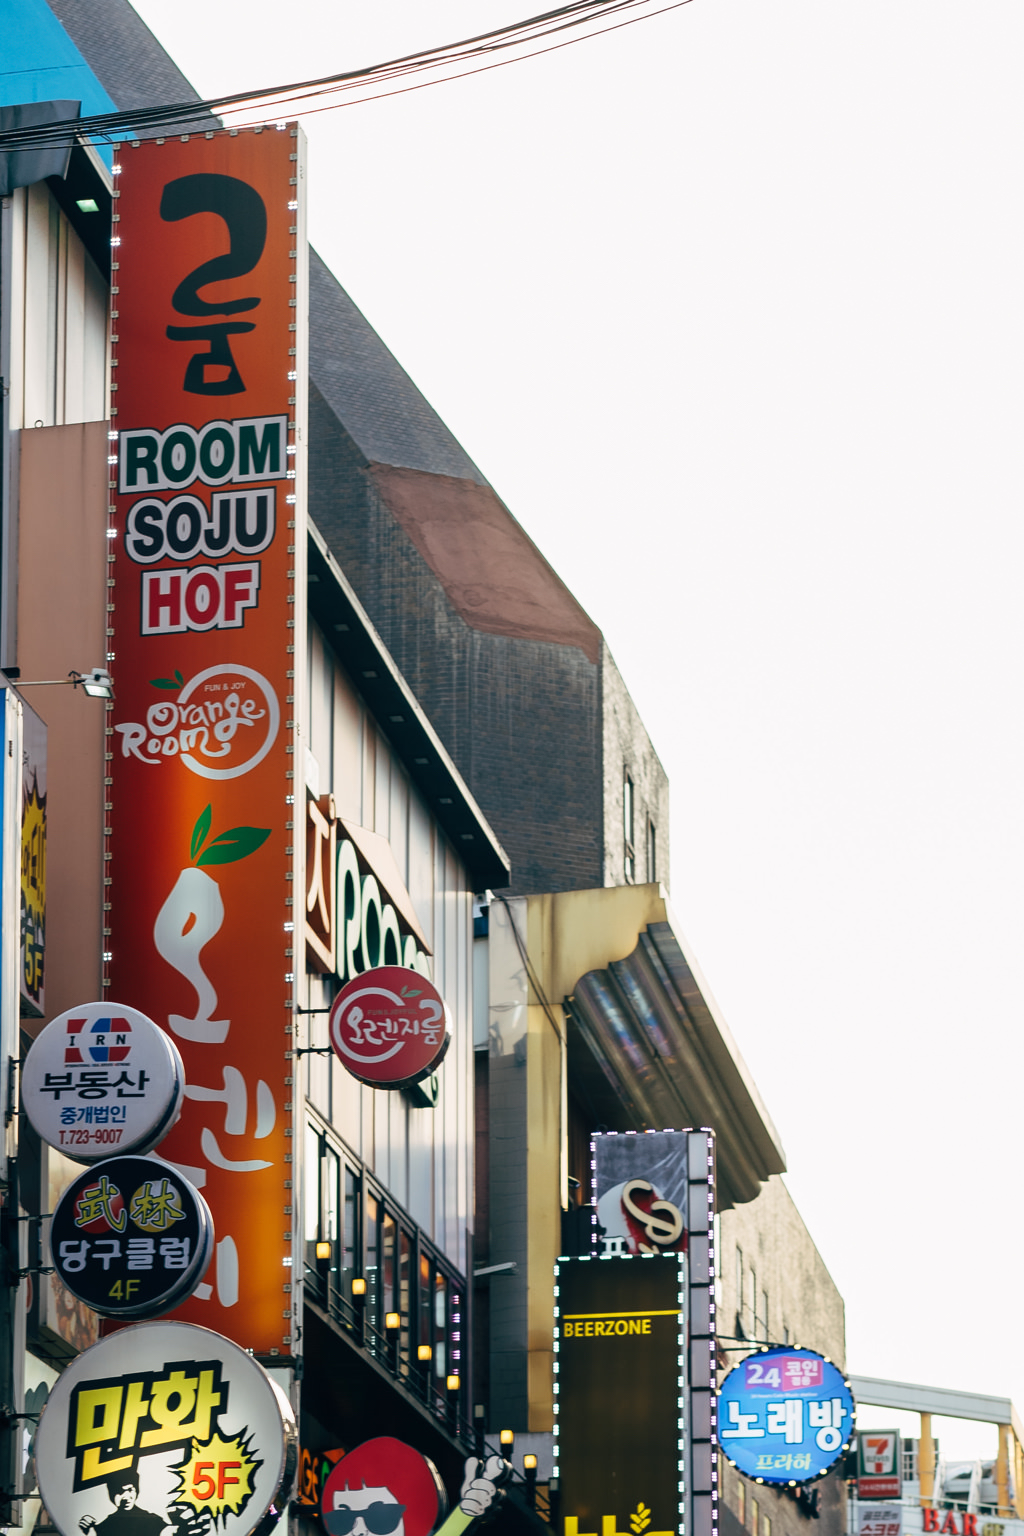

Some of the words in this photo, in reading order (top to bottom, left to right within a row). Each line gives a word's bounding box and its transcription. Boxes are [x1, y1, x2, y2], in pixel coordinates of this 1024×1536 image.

[160, 172, 268, 397] 룸
[121, 418, 285, 491] ROOM
[128, 490, 274, 561] SOJU
[144, 564, 258, 632] HOF
[24, 930, 44, 991] 5F
[347, 1000, 442, 1046] 오렌지룸
[39, 1070, 151, 1100] 부동산
[59, 1105, 127, 1126] 중개법인
[58, 1128, 123, 1146] T.723-9007
[59, 1237, 191, 1272] 당구클럽
[108, 1279, 141, 1301] 4F
[562, 1318, 653, 1338] BEERZONE
[746, 1363, 782, 1388] 24
[785, 1360, 818, 1377] 코인
[74, 1369, 222, 1482] 만화
[721, 1397, 848, 1453] 노래방
[191, 1460, 242, 1501] 5F
[755, 1453, 812, 1471] 프라하
[860, 1523, 901, 1536] 스크린
